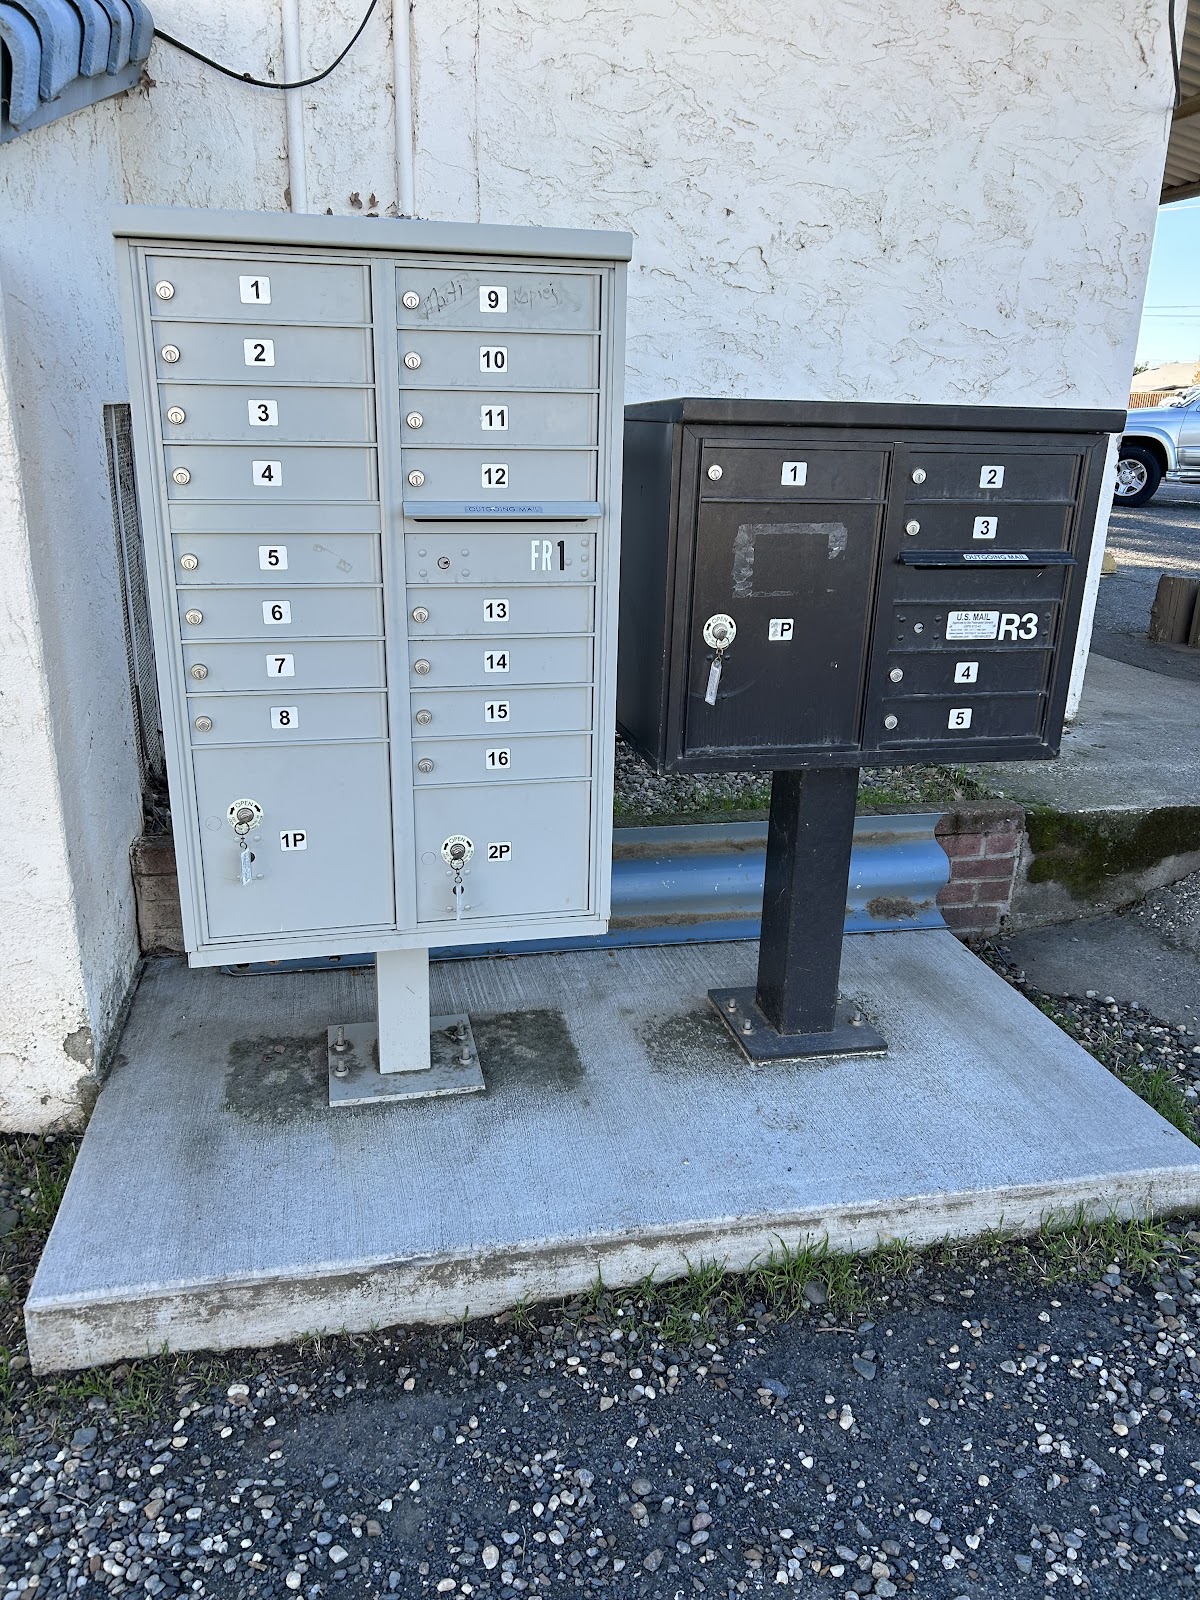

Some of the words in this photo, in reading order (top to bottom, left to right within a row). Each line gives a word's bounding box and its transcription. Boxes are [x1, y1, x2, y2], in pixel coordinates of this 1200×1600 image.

[251, 281, 260, 299] 1
[488, 291, 499, 309] 9
[254, 344, 266, 361] 2
[483, 351, 505, 368] 10
[258, 404, 269, 422] 3
[485, 410, 505, 427] 11
[262, 464, 273, 481] 4
[484, 468, 505, 485] 12
[790, 466, 797, 482] 1
[987, 469, 997, 484] 2
[980, 520, 990, 535] 3
[268, 550, 279, 566] 5
[531, 540, 553, 571] FR
[557, 540, 565, 571] 1
[272, 605, 283, 620] 6
[486, 603, 506, 618] 13
[956, 613, 971, 621] U.S.
[972, 613, 991, 621] MAIL
[711, 616, 729, 624] OPEN
[998, 612, 1039, 641] R3
[275, 658, 286, 673] 7
[487, 654, 507, 669] 14
[961, 666, 971, 680] 4
[279, 710, 290, 725] 8
[488, 704, 508, 719] 15
[955, 712, 965, 725] 5
[489, 752, 508, 766] 16
[235, 800, 254, 808] OPEN
[281, 833, 305, 848] 1P
[448, 836, 466, 844] OPEN
[489, 845, 510, 859] 2P
